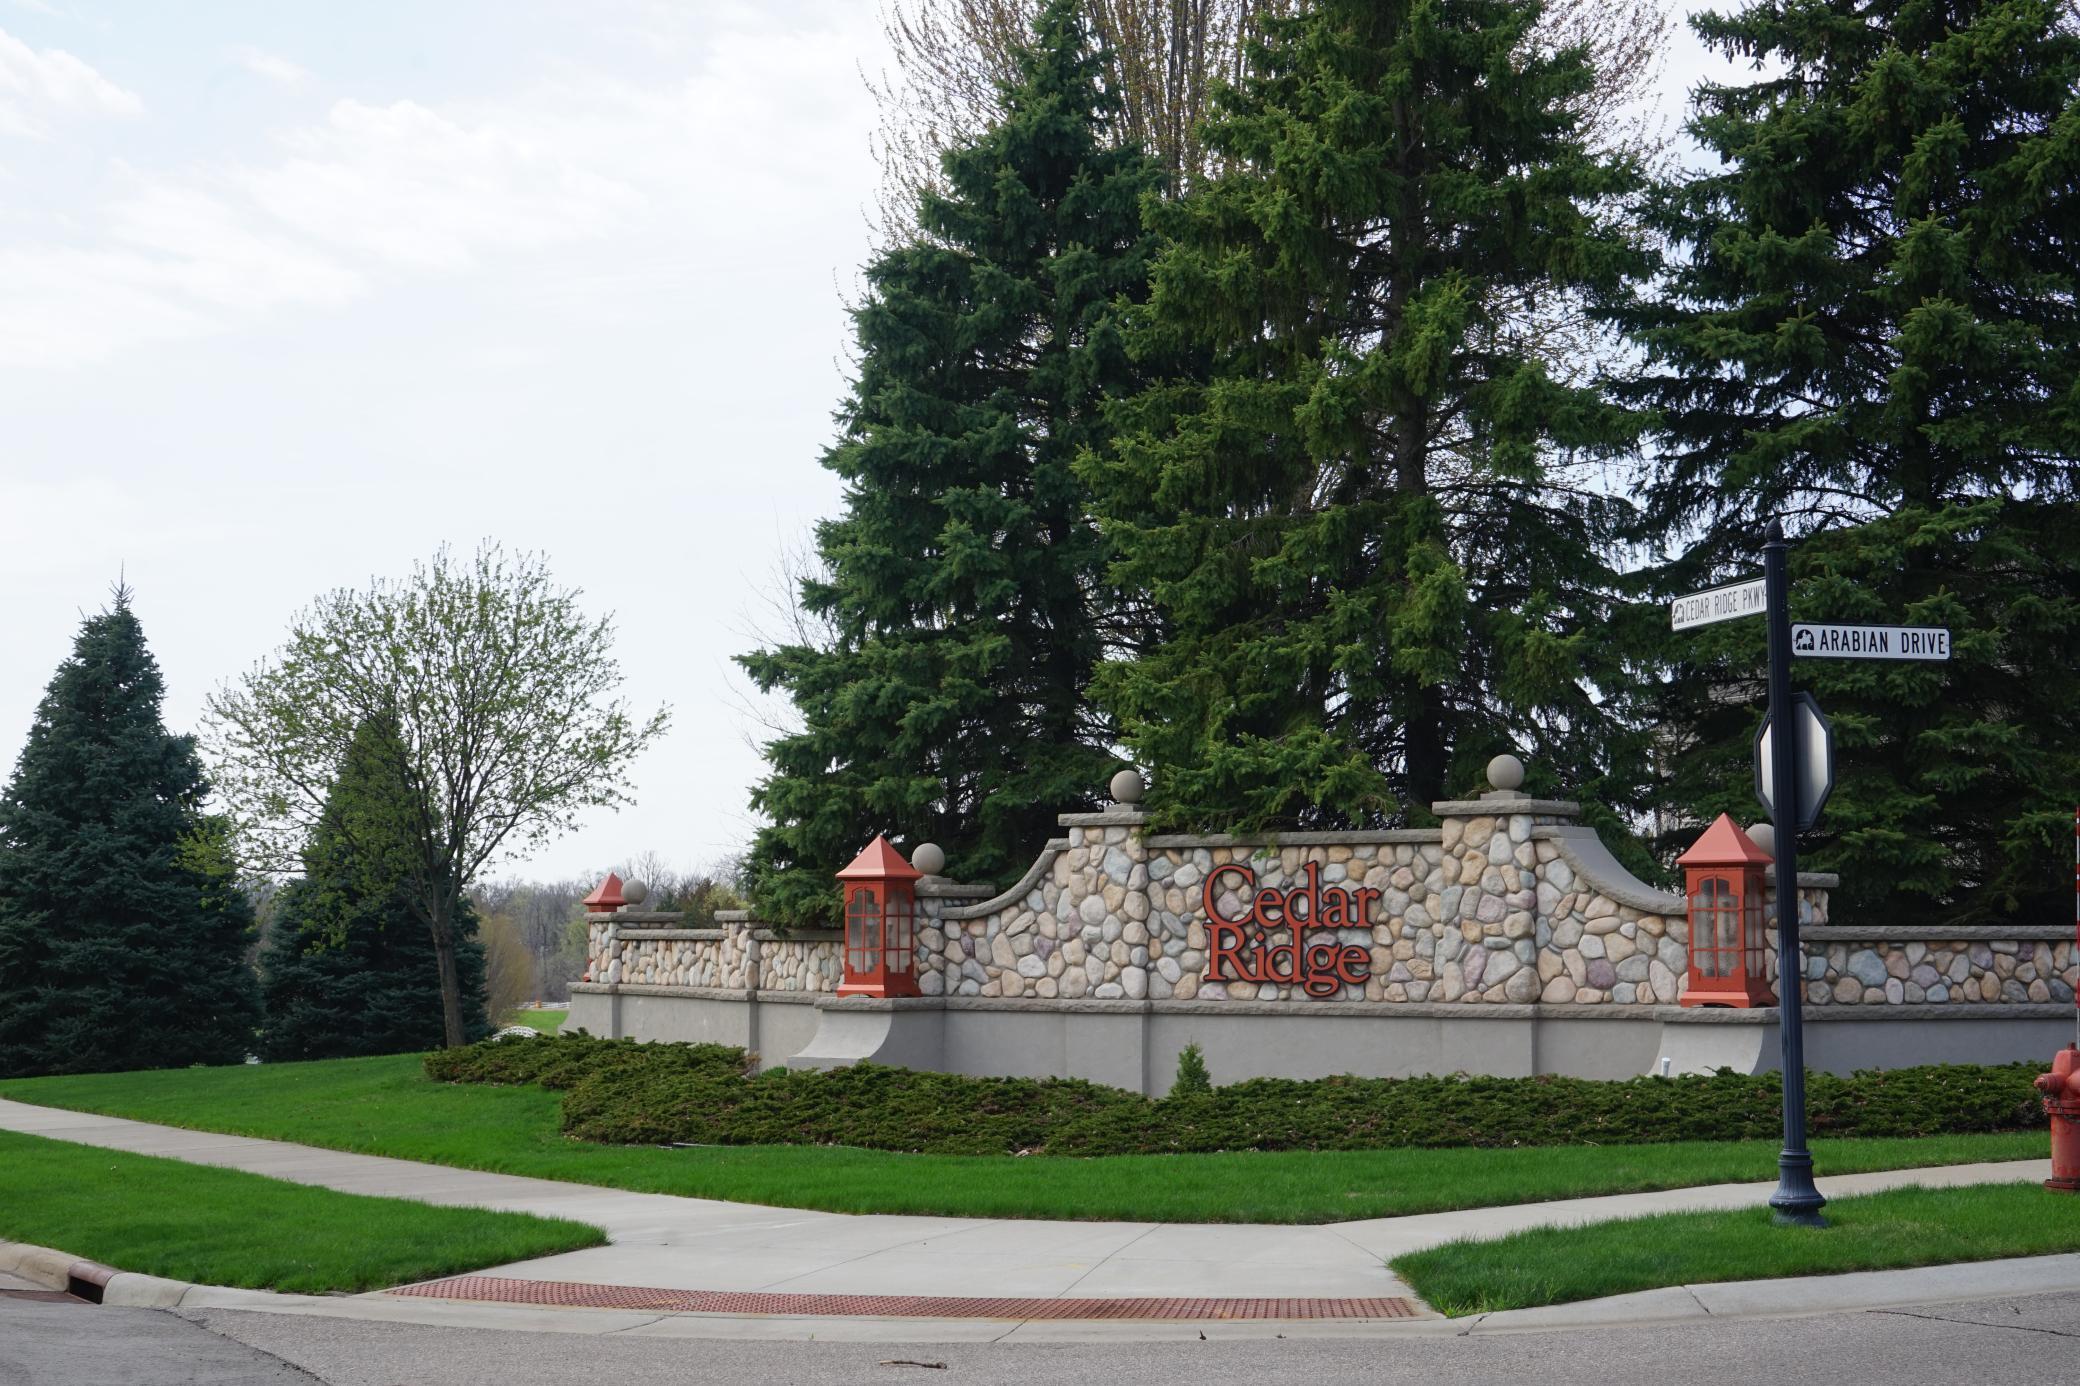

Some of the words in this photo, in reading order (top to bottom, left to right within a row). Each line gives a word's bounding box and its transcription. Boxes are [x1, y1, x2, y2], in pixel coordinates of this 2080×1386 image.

[1686, 597, 1710, 621] CEDAR
[1714, 591, 1737, 614] RIDGE
[1743, 584, 1766, 609] PKWY
[1820, 629, 1888, 653] ARABIAN
[1901, 632, 1946, 655] DRIVE
[1202, 860, 1382, 929] Cedar
[1203, 922, 1372, 997] Ridge
